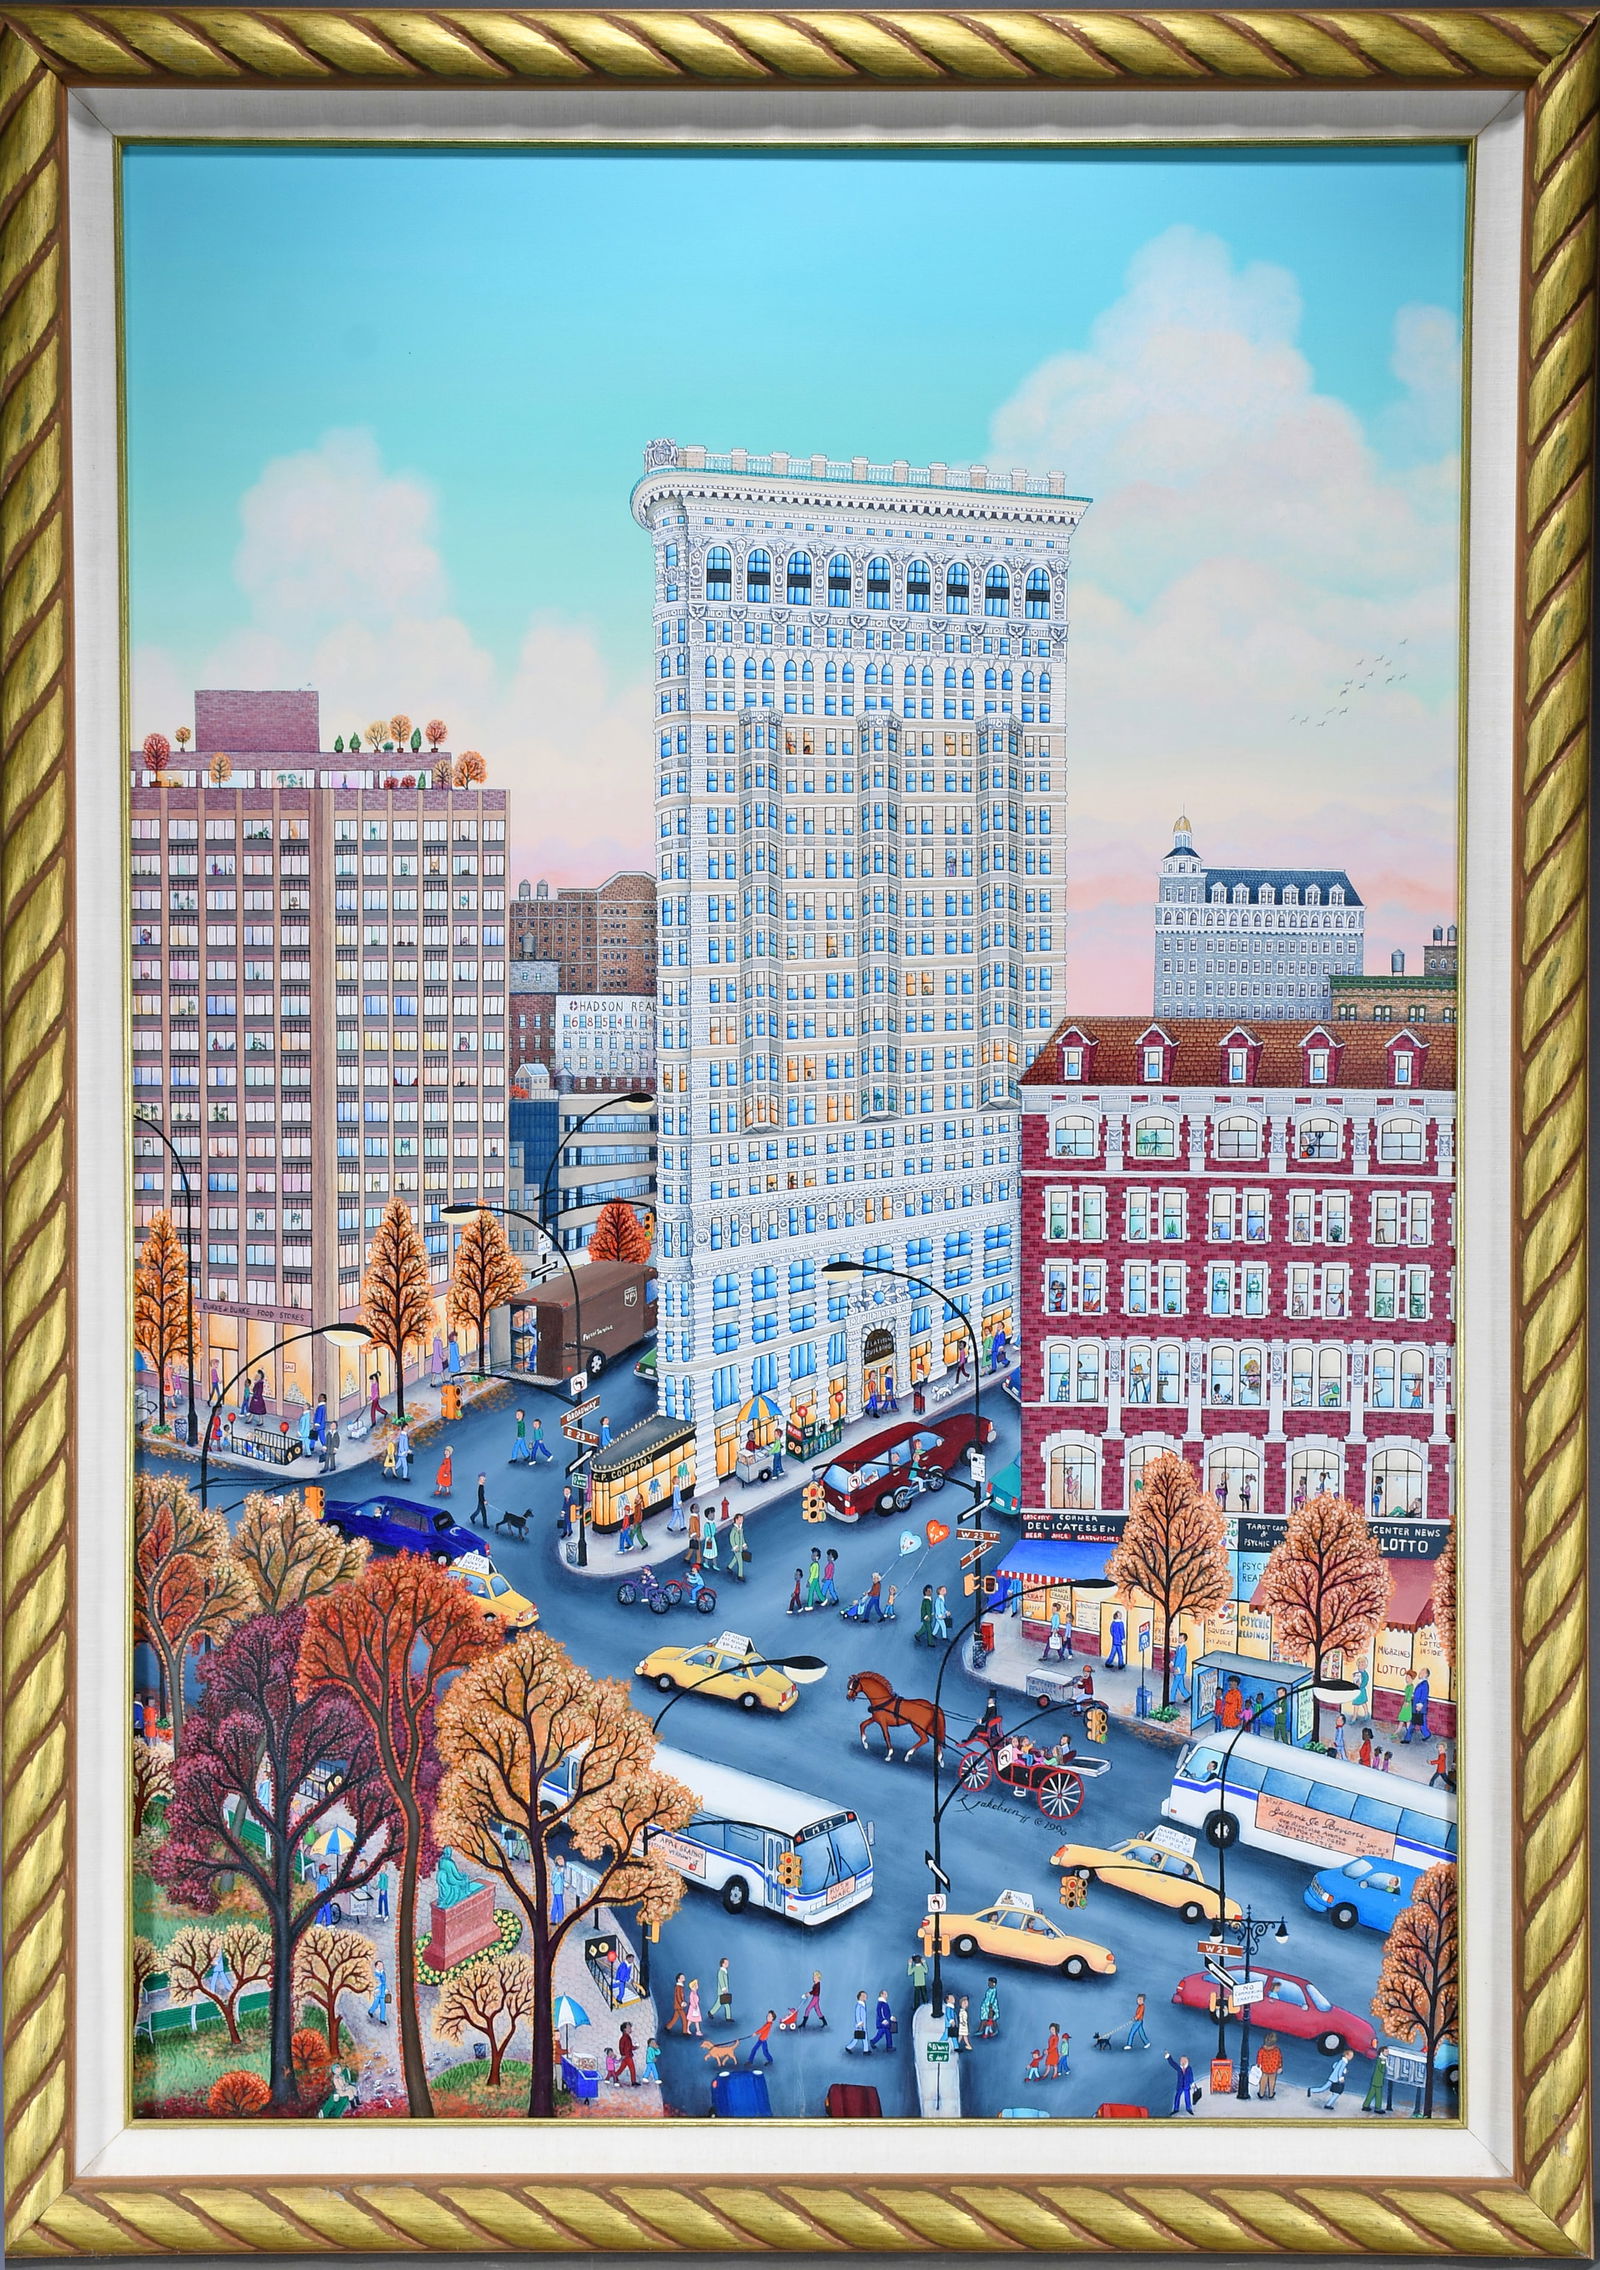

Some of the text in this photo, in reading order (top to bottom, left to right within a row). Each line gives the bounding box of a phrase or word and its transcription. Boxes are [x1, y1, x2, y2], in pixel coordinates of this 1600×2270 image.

[256, 1309, 275, 1319] FOOD
[279, 1312, 305, 1322] STORES
[566, 1400, 597, 1422] BROADWAY
[567, 1428, 572, 1437] E
[576, 1431, 586, 1441] 23
[611, 1453, 654, 1479] COMPANY
[1059, 1514, 1098, 1522] CORNER
[1027, 1521, 1116, 1533] DELICATESSEN
[1246, 1523, 1272, 1531] TAROT
[1372, 1525, 1441, 1538] CENTER NEWS
[961, 1531, 970, 1539] W
[973, 1532, 985, 1540] 23
[1077, 1534, 1120, 1543] SANDWICHES
[969, 1543, 988, 1561] 5 AV
[1381, 1538, 1429, 1554] LOTTO
[1240, 1616, 1270, 1629] PSYCHIC
[1239, 1630, 1270, 1641] READINGS
[1420, 1632, 1437, 1640] PLAY
[1420, 1641, 1441, 1649] LOTTO
[1420, 1648, 1443, 1657] INSIDE
[1377, 1663, 1407, 1677] LOTTO
[1205, 1945, 1229, 1954] W 23
